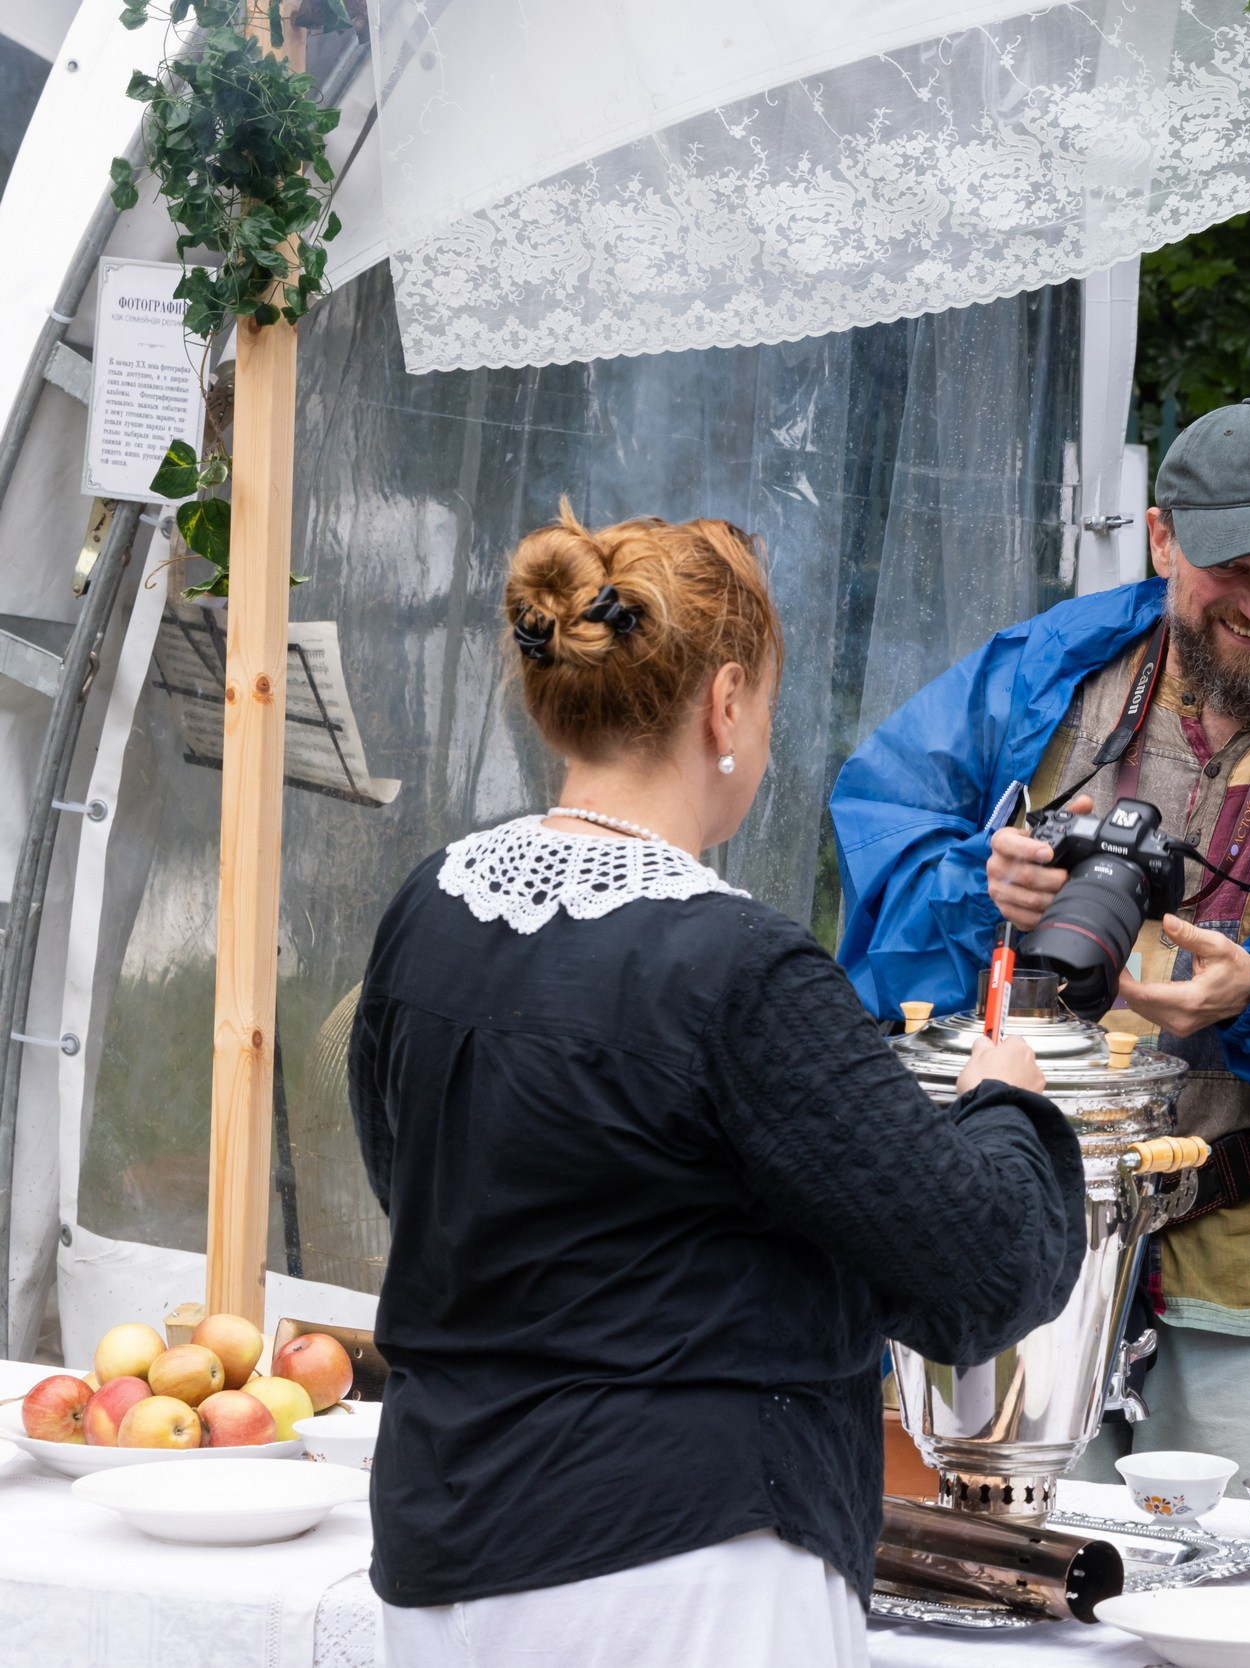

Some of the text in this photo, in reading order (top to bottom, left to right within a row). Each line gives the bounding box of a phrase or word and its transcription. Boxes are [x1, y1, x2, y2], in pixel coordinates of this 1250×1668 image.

[124, 315, 161, 325] семейная
[161, 318, 183, 328] рели
[109, 357, 114, 365] К
[115, 360, 134, 368] началу
[160, 364, 191, 374] фотография
[106, 388, 130, 397] альбомы.
[138, 382, 164, 390] появились
[164, 385, 189, 393] семейные
[105, 399, 134, 407] оставалось
[125, 411, 154, 419] готовились
[156, 414, 177, 423] заранее,
[124, 421, 144, 429] лучшие
[145, 423, 166, 431] наряды
[103, 428, 121, 436] тельно
[124, 430, 149, 439] выбирали
[102, 438, 121, 446] снимки
[101, 448, 122, 456] увидеть
[1127, 662, 1154, 715] Canon
[1101, 841, 1128, 855] Canon
